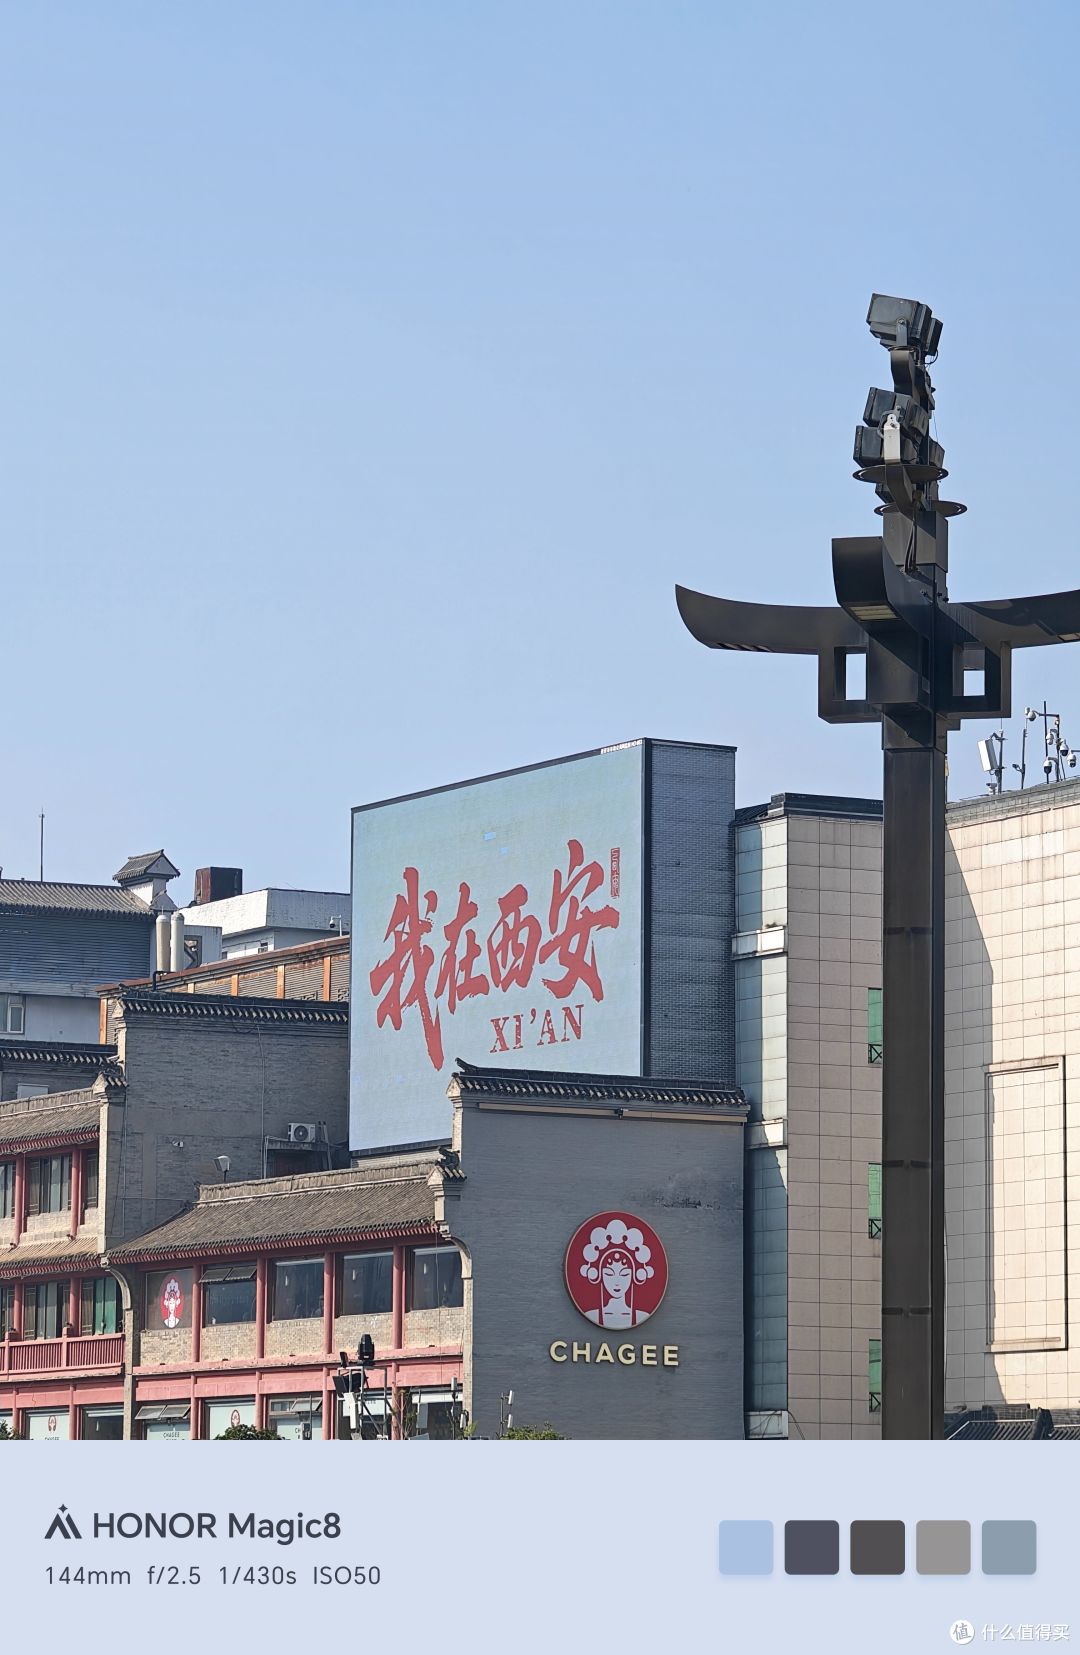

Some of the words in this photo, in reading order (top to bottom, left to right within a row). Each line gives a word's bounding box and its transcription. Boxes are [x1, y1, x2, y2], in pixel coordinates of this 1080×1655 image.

[369, 839, 620, 1071] 我在西安
[549, 1340, 679, 1366] CHAGEE
